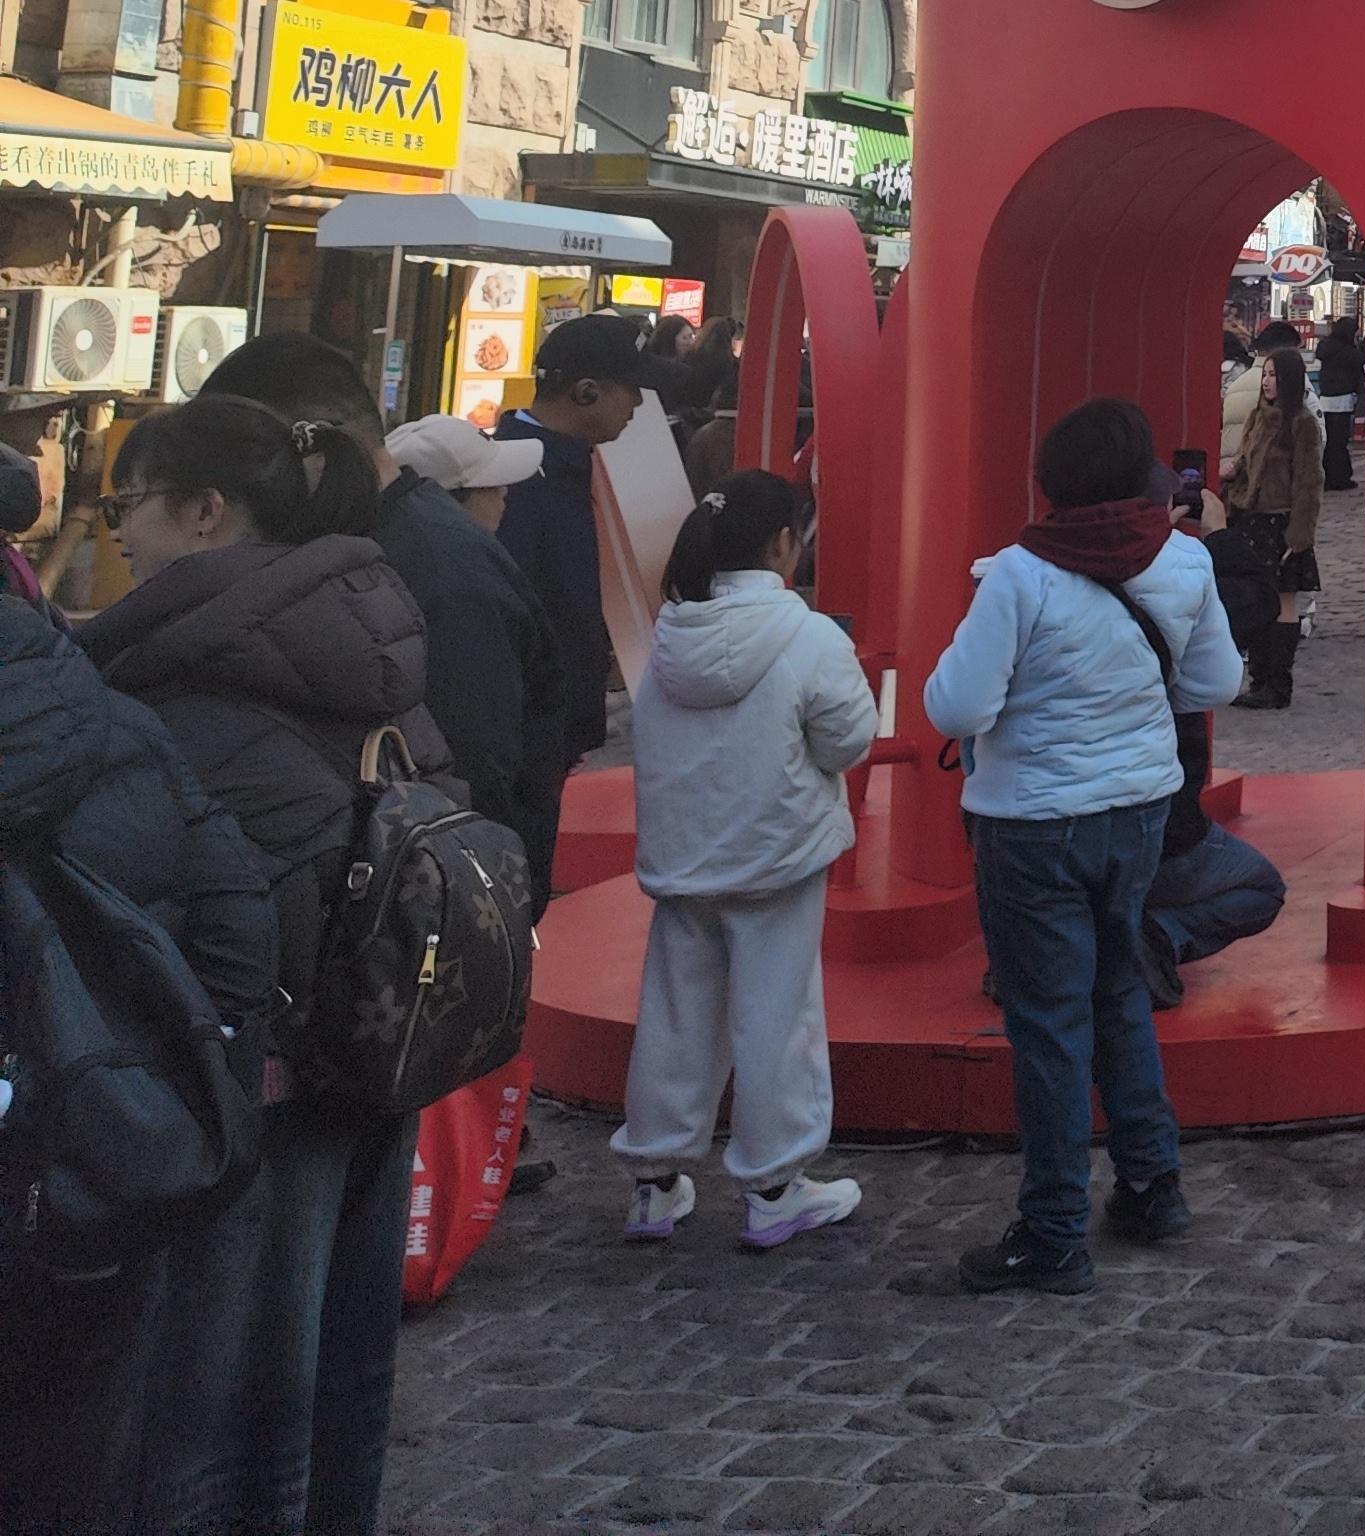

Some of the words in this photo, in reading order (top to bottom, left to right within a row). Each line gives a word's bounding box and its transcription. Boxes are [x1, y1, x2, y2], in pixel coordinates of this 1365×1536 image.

[282, 11, 323, 30] NO.115
[293, 47, 442, 124] 鸡柳大人
[1278, 253, 1318, 276] DQ
